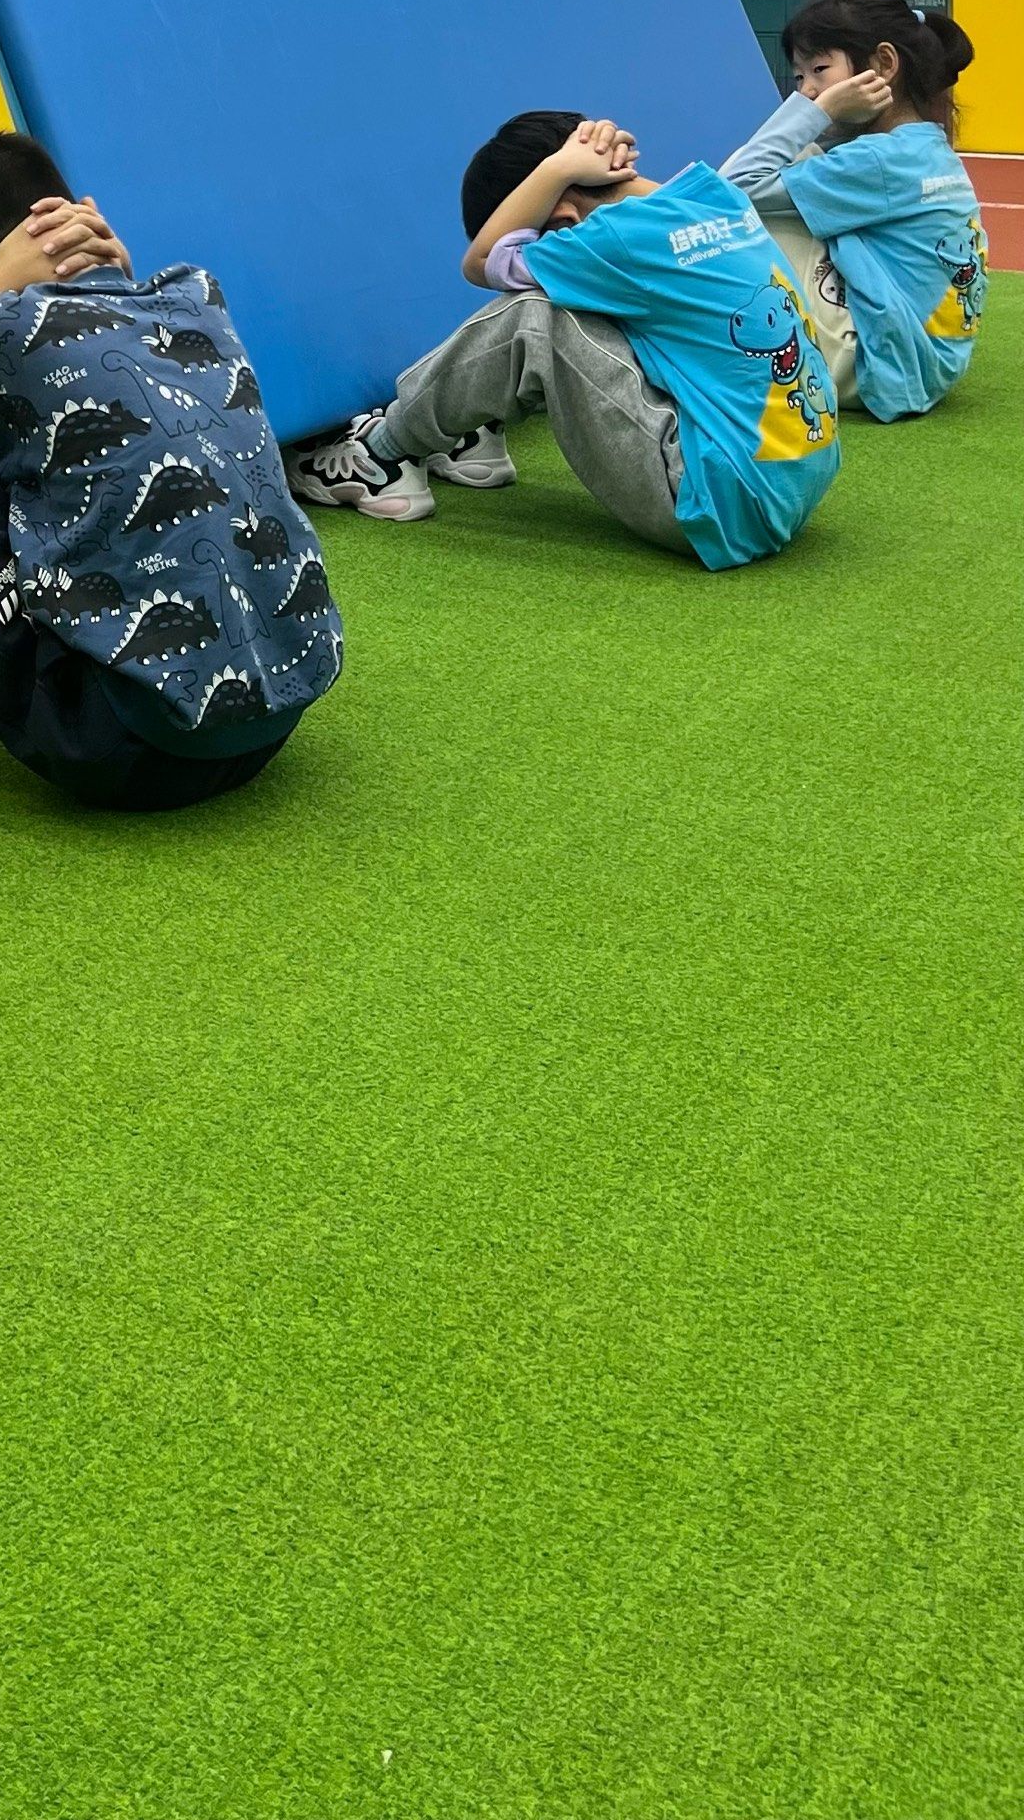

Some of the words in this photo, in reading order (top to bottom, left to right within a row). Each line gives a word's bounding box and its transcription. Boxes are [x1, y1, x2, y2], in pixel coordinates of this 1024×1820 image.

[42, 365, 70, 385] XIAO
[54, 367, 88, 389] BEIKE
[196, 433, 219, 454] XIAO
[200, 444, 226, 469] BEIKE
[135, 553, 163, 570] XIAO
[145, 557, 179, 575] BEIKE
